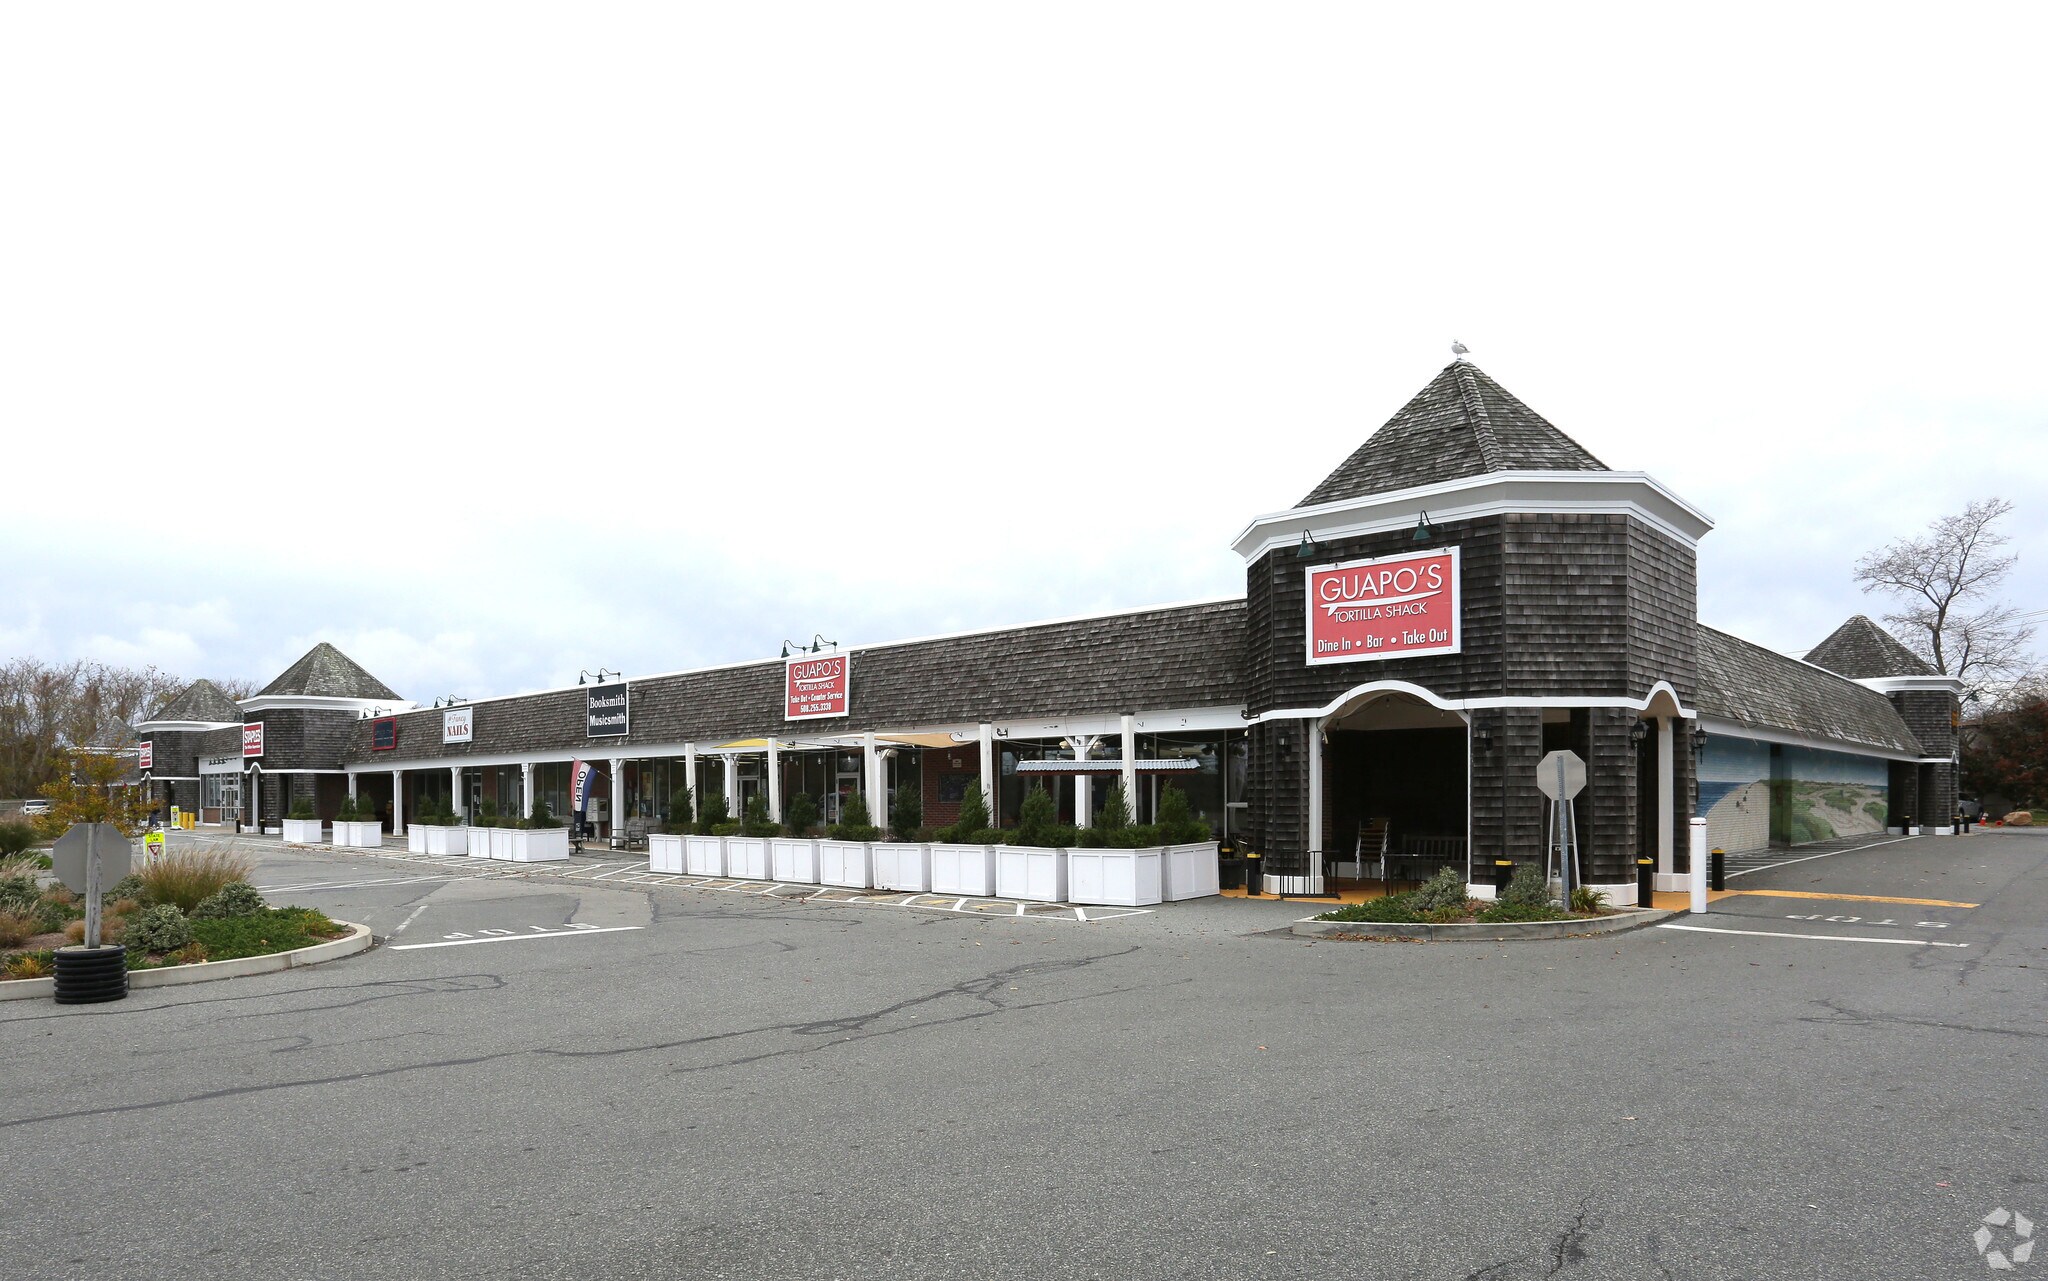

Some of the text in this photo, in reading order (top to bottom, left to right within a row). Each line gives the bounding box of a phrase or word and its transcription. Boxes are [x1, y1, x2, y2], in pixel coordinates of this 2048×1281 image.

[1319, 563, 1443, 602] GUAPO'S
[1333, 601, 1428, 624] TORTILLA SHACK
[1317, 628, 1448, 653] Dine In Bar Take Out
[793, 660, 841, 679] GUAPO'S
[798, 681, 835, 692] TORTILLA SHACK
[589, 693, 626, 709] Booksmith
[827, 691, 843, 700] Service
[589, 712, 626, 727] Musicsmith
[446, 723, 469, 737] NAILS
